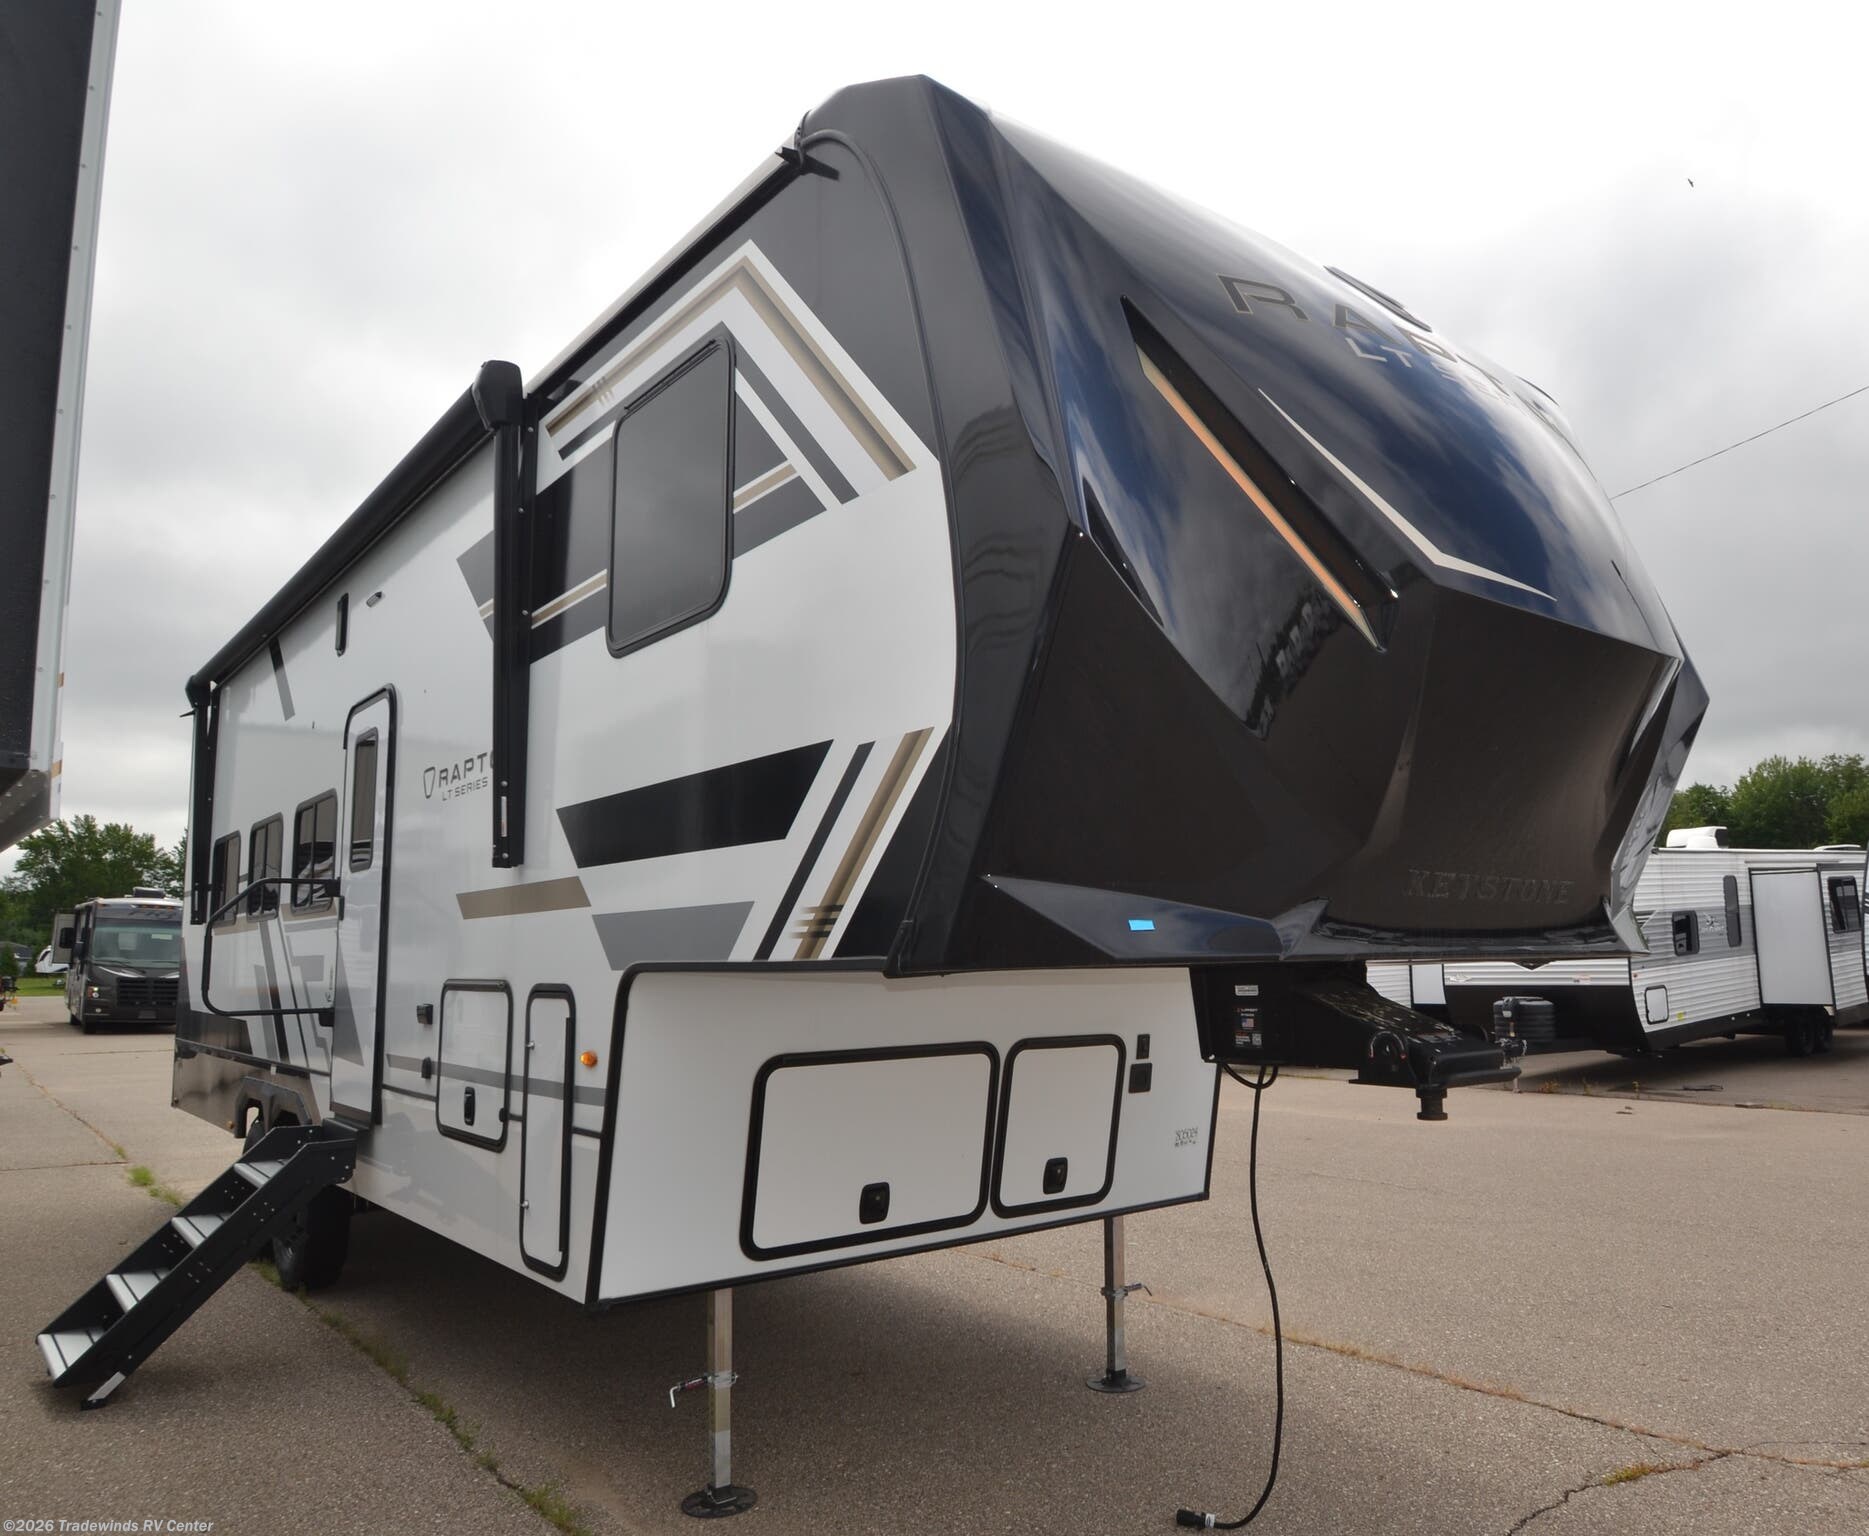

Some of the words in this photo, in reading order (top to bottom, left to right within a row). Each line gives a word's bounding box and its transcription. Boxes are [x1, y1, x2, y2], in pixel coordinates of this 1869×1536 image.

[441, 789, 453, 801] LT
[454, 776, 488, 797] SERIES
[1404, 868, 1576, 905] KEYSTONE
